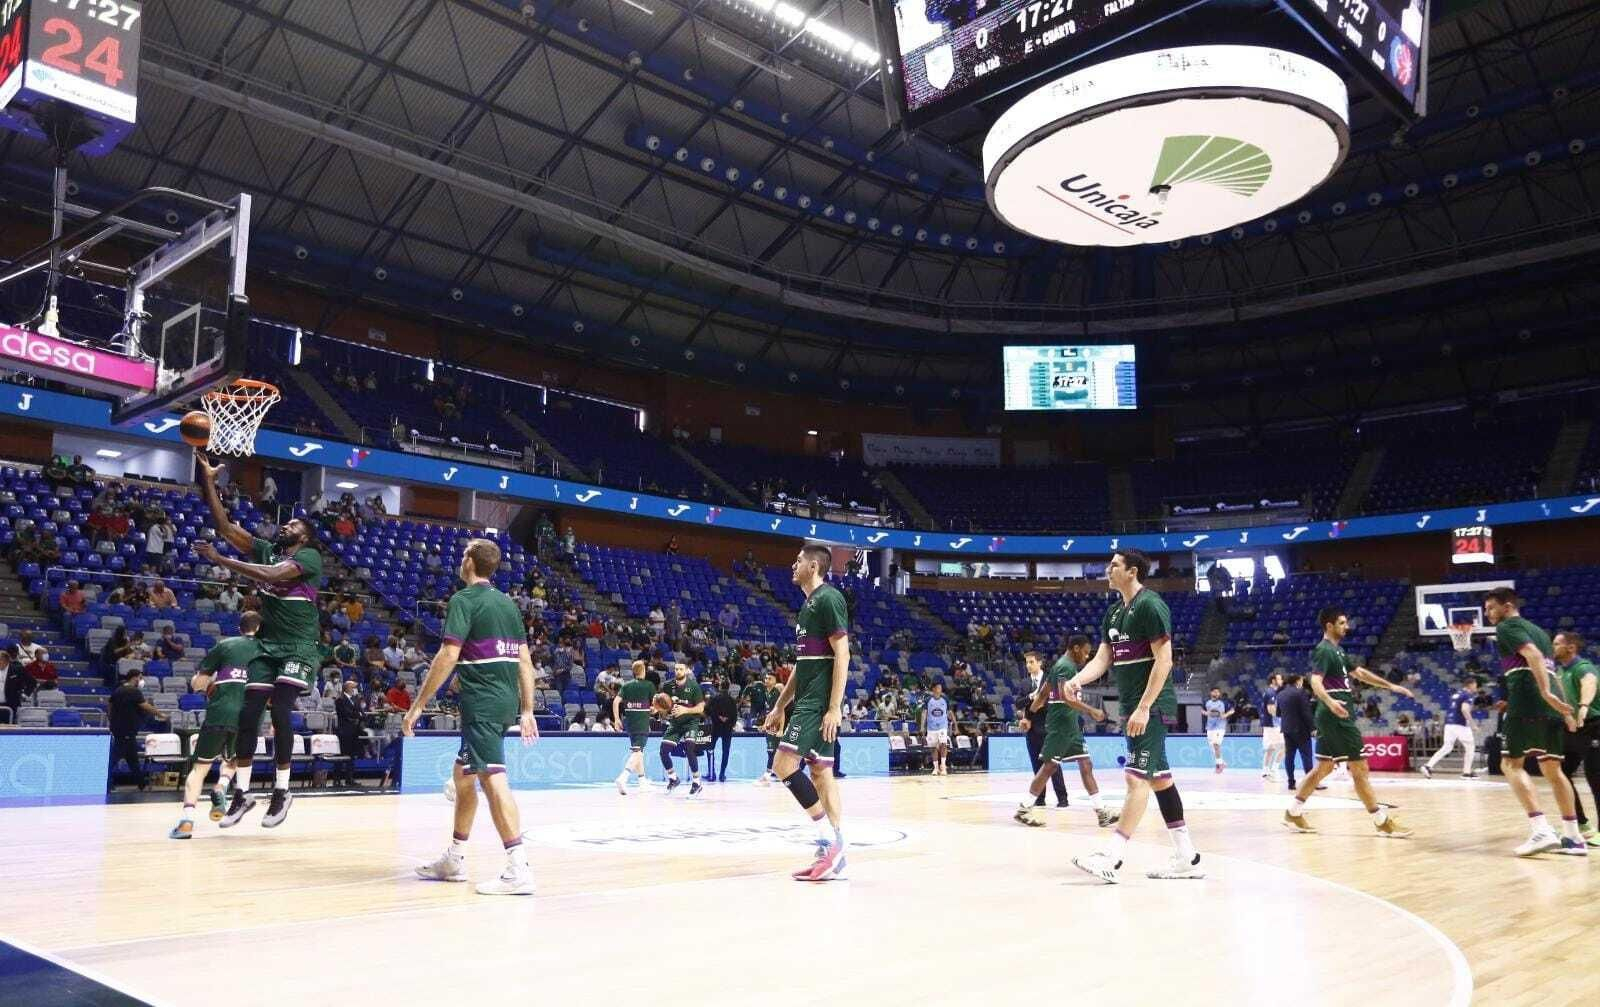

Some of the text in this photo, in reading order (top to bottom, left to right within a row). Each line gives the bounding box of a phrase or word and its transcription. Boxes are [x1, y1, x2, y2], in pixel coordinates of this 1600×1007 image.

[49, 0, 141, 30] :27
[42, 17, 124, 87] 24
[976, 28, 988, 49] 0
[1060, 174, 1159, 230] Unicaja
[2, 332, 95, 374] desa
[1455, 538, 1480, 554] 24
